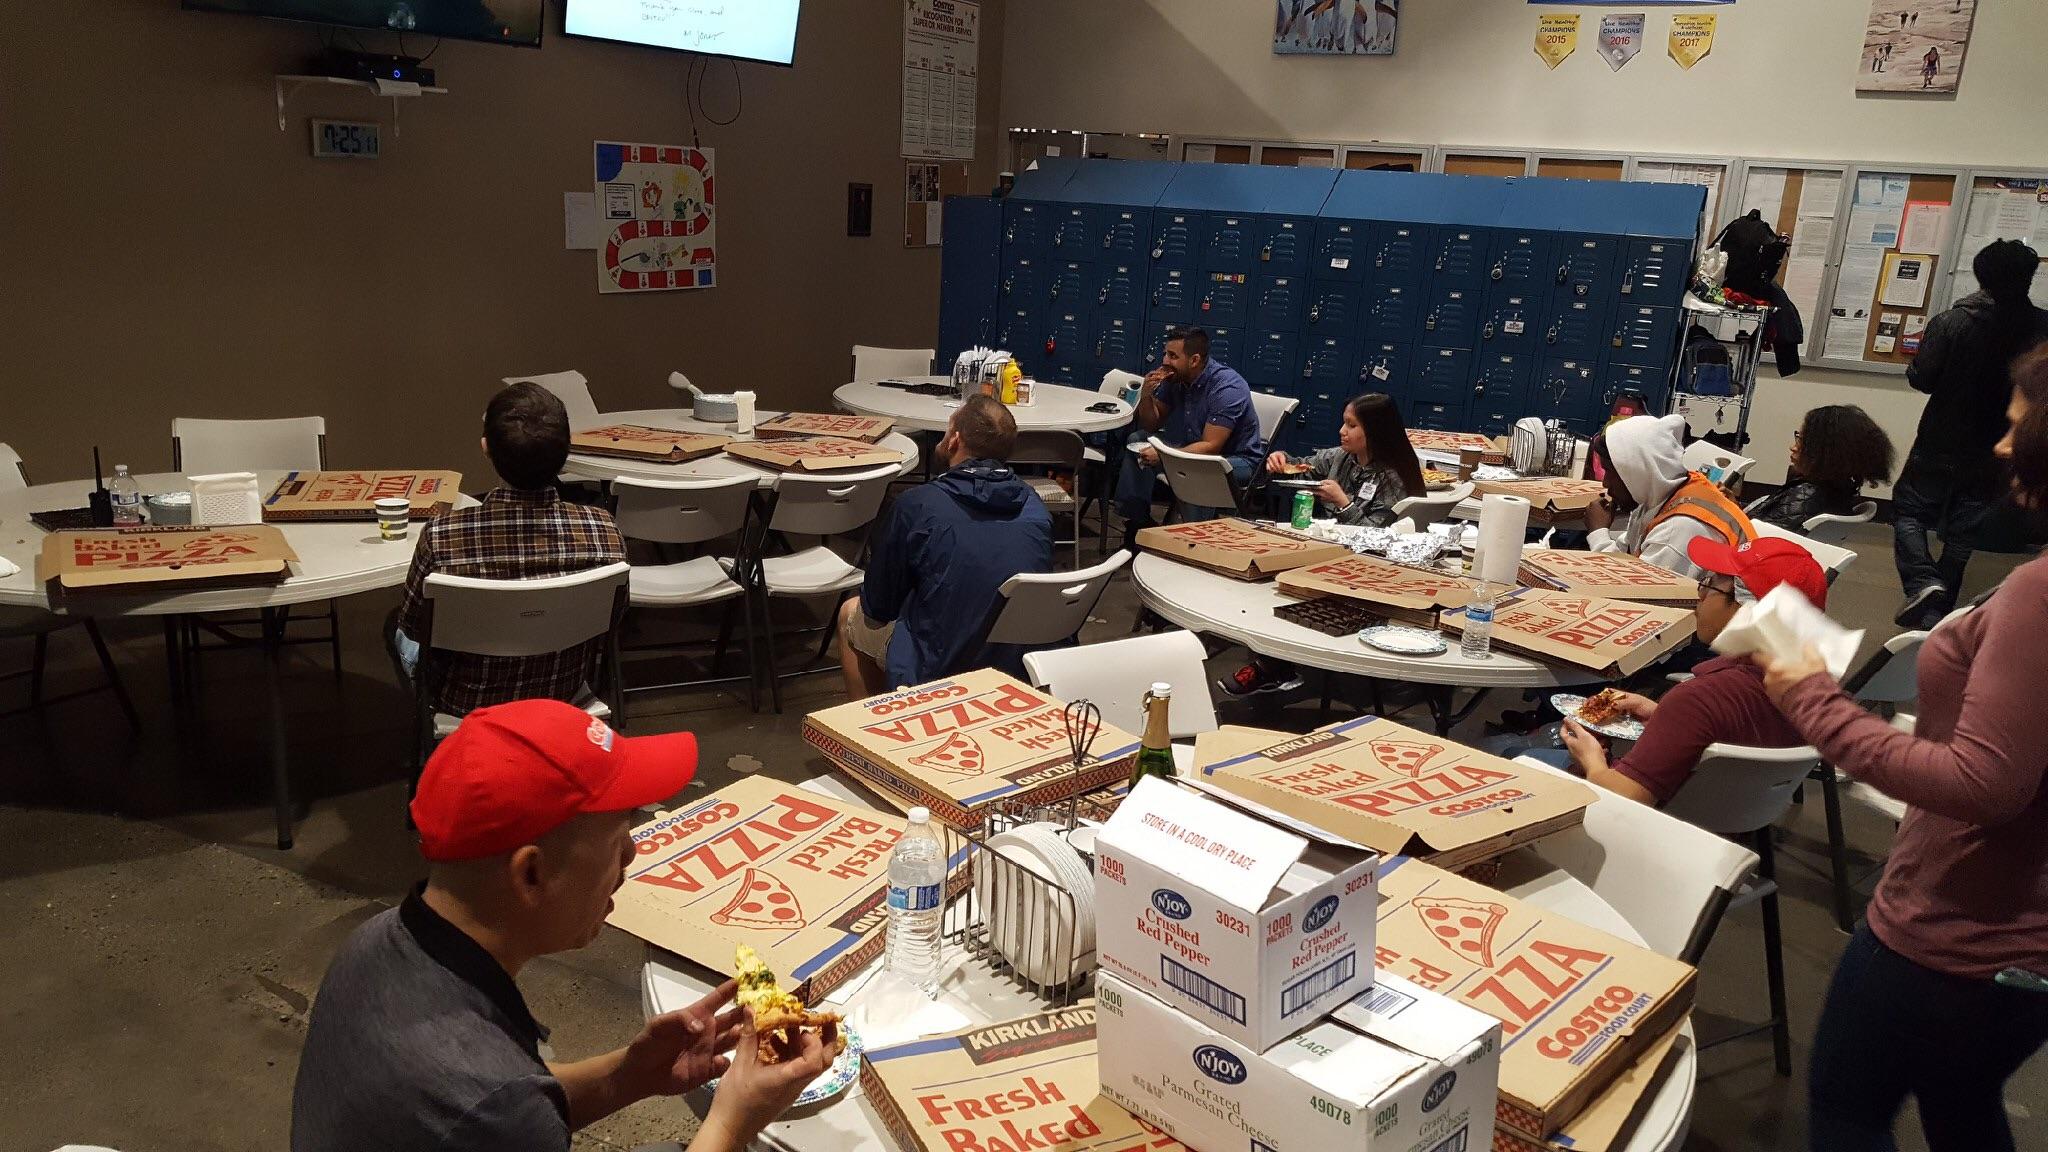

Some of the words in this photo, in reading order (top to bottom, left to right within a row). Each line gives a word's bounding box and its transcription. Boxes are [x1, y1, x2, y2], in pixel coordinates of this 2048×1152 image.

[1546, 35, 1566, 44] 2015
[1610, 36, 1630, 46] 2016
[1680, 38, 1700, 47] 2017
[75, 545, 257, 567] PIZZA
[1546, 608, 1651, 649] PIZZA
[1612, 620, 1664, 646] COSTCO
[863, 683, 1048, 743] PIZZA
[871, 685, 969, 715] COSTCO
[1264, 731, 1337, 759] KIRKLAND
[1331, 765, 1514, 816] PIZZA
[1429, 788, 1524, 817] COSTCO
[634, 803, 740, 855] COSTCO
[634, 794, 840, 893] PIZZA
[1141, 813, 1167, 831] STORE
[1166, 821, 1178, 836] IN
[1177, 827, 1186, 840] A
[1185, 832, 1208, 851] COOL
[1207, 841, 1227, 860] DRY
[1227, 850, 1257, 871] PLACE
[1100, 854, 1125, 876] 1000
[1100, 866, 1127, 887] PACKETS
[1345, 871, 1374, 896] 30231
[1145, 907, 1200, 946] Crushed
[1216, 910, 1251, 938] 30231
[1266, 927, 1293, 947] PACKETS
[1267, 913, 1292, 936] 1000
[1300, 922, 1341, 951] Crushed
[1136, 917, 1161, 942] Red
[1164, 933, 1211, 967] Pepper
[1292, 950, 1312, 970] Red
[1314, 932, 1348, 959] Pepper
[1099, 986, 1122, 1008] 1000
[1458, 940, 1607, 1034] ZZA
[968, 1008, 1096, 1050] KIRKLAND
[1536, 985, 1635, 1059] COSTCO
[1600, 1017, 1628, 1040] FOOD
[1625, 992, 1654, 1018] COURT
[1292, 1035, 1333, 1058] PLACE
[1466, 1038, 1493, 1066] 49078
[1161, 1072, 1224, 1120] Parmesan
[1228, 1111, 1280, 1150] Cheese
[1193, 1079, 1241, 1115] Grated
[1310, 1096, 1352, 1126] 49078
[1375, 1103, 1398, 1128] 1000
[1375, 1119, 1399, 1138] ACKETS
